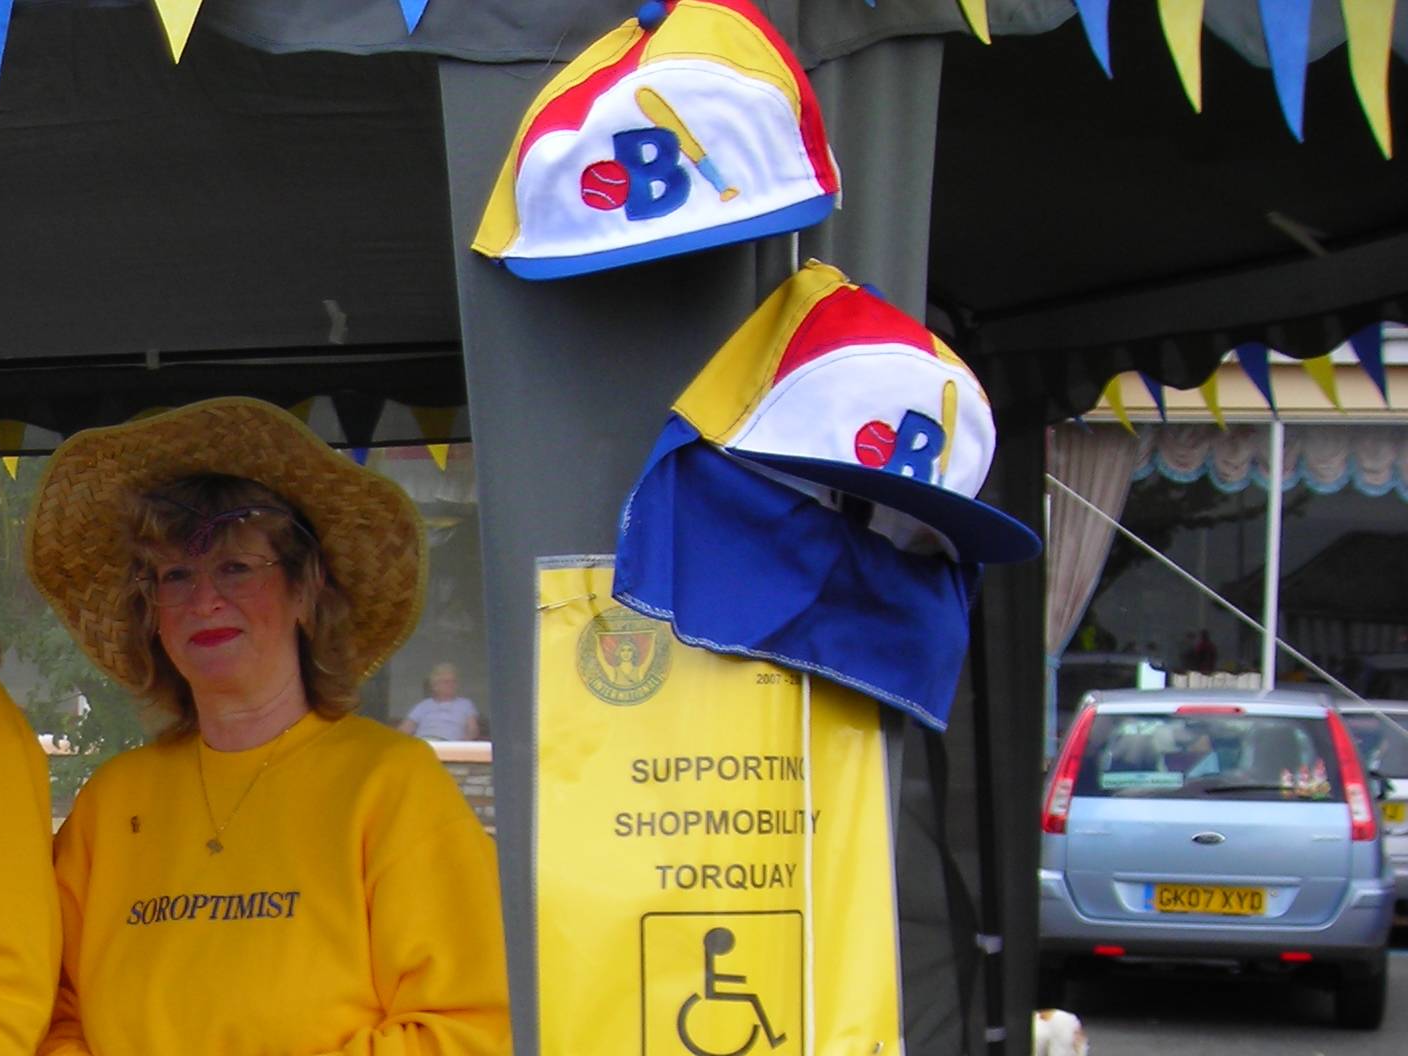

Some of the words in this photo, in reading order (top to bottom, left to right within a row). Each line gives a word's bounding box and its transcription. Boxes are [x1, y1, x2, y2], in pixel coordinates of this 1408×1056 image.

[611, 127, 691, 221] B
[756, 673, 782, 685] 2007
[614, 809, 821, 837] SHOPMOBILITY
[655, 863, 797, 890] TORQUAY
[127, 891, 300, 926] SOROPTIMIST
[1157, 887, 1214, 909] GK07
[1221, 888, 1264, 911] XYD
